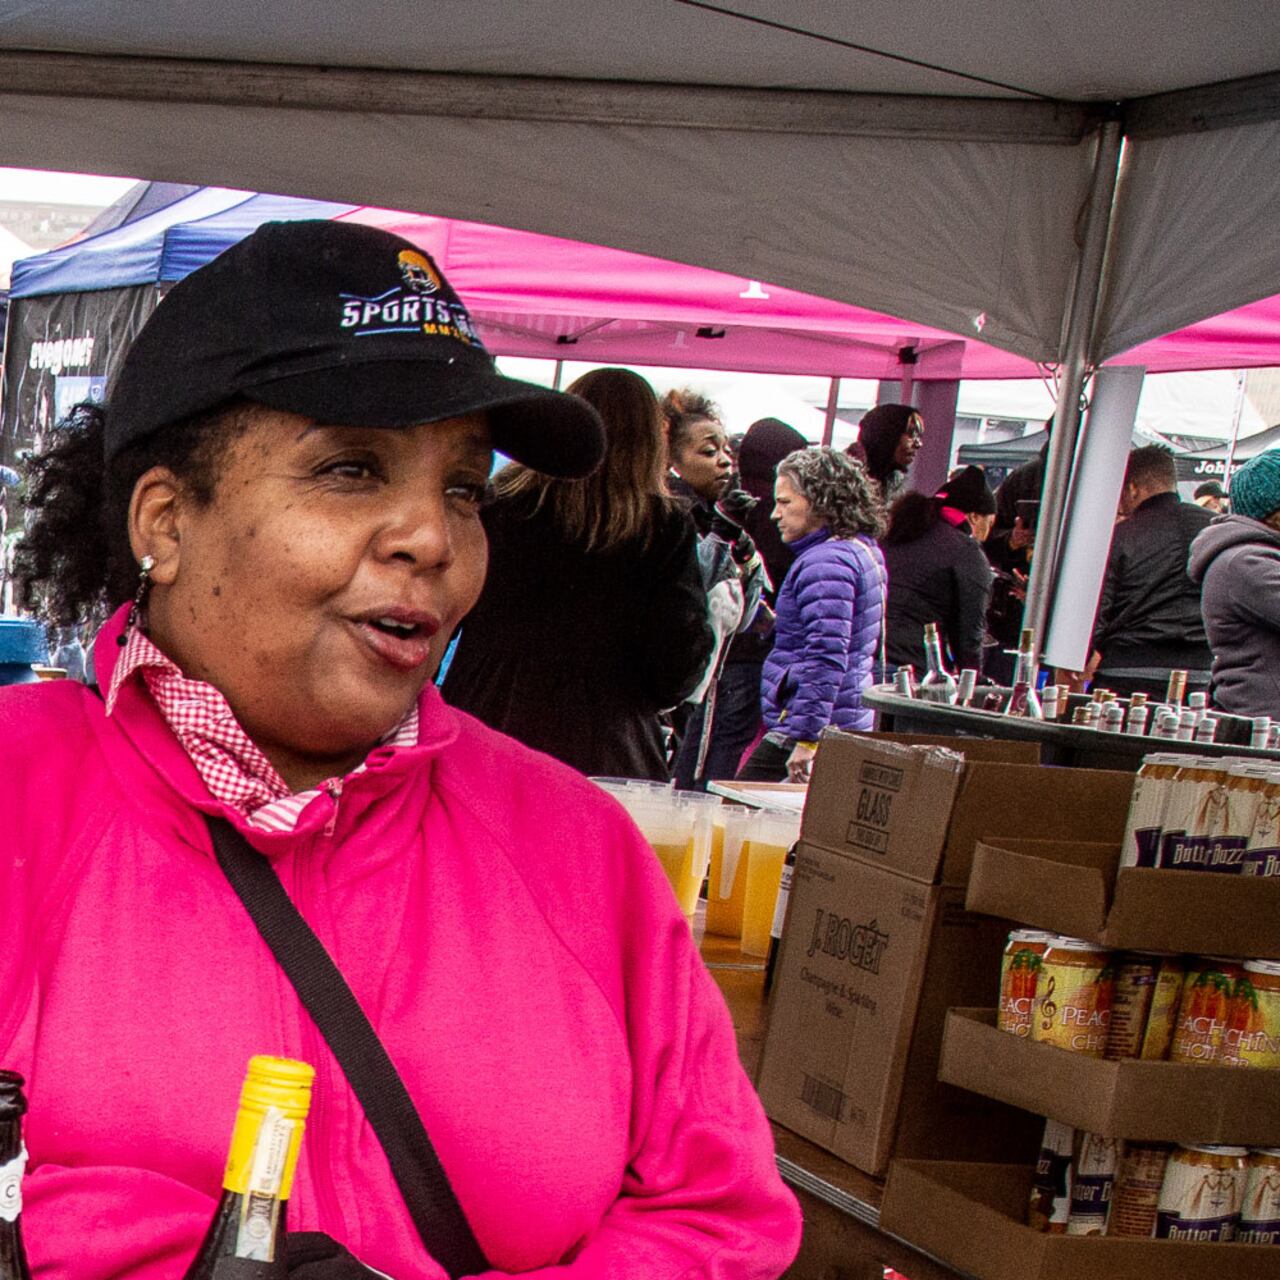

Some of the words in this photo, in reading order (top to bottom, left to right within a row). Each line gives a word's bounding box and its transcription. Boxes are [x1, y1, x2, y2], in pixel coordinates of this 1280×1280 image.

[340, 296, 451, 328] SPORTS
[856, 788, 892, 827] GLASS
[1061, 1005, 1111, 1027] PEAC
